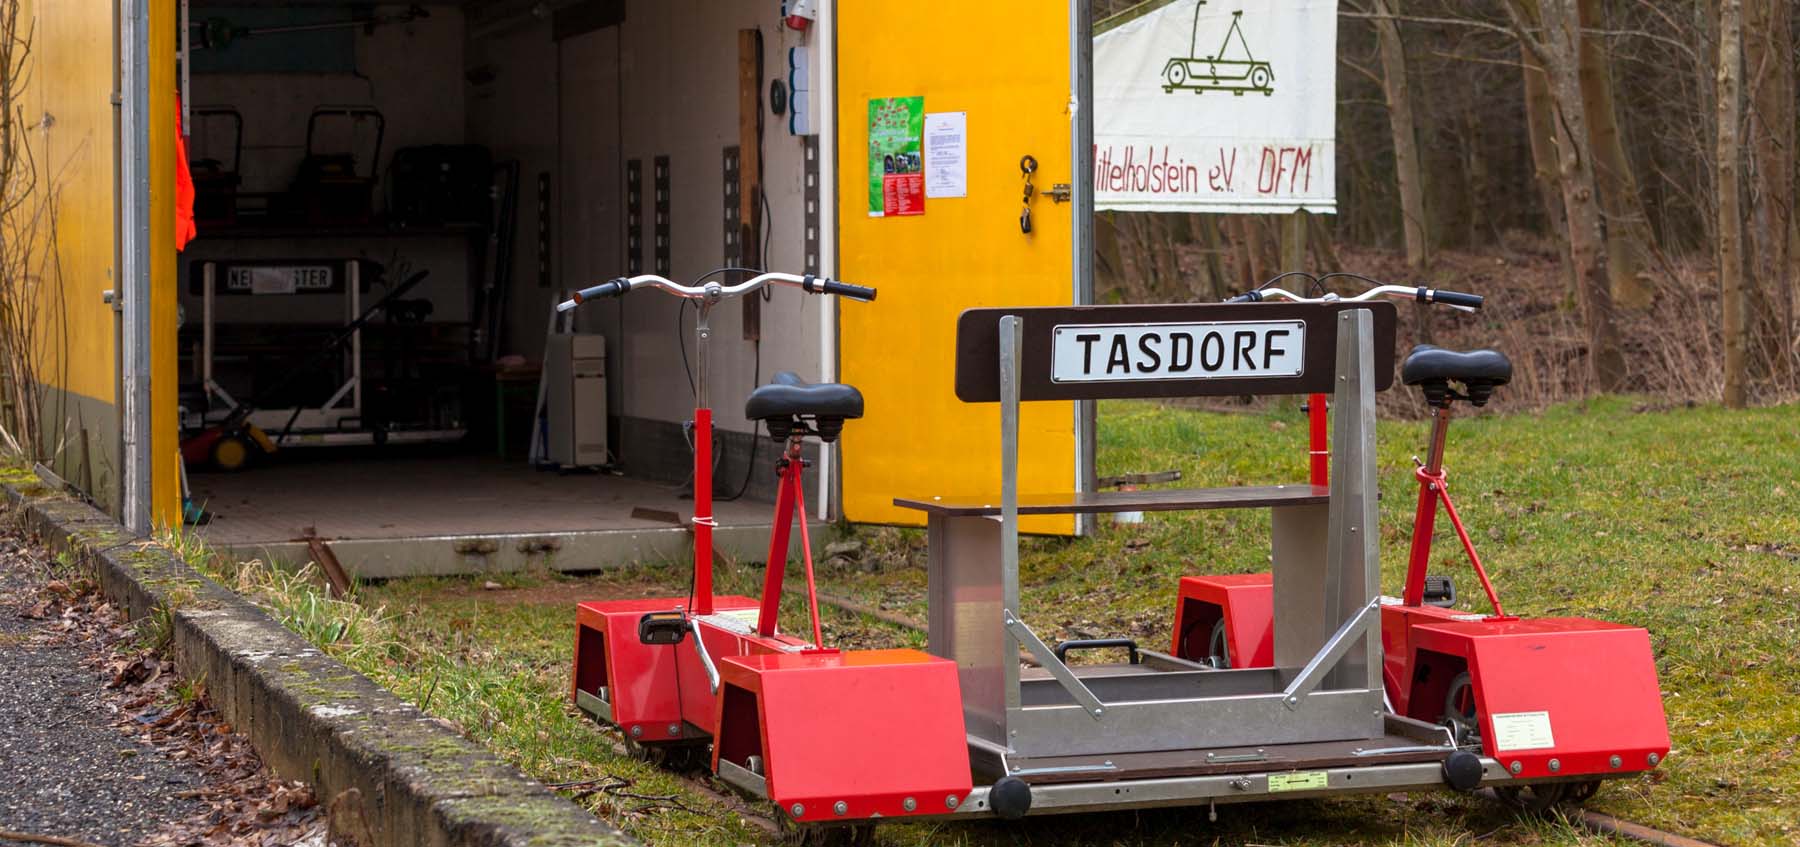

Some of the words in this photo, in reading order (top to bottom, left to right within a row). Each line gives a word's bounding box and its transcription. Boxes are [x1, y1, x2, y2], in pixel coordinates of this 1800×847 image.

[1092, 144, 1198, 194] ittelholstein
[1258, 146, 1312, 194] DFM
[1076, 330, 1290, 374] TASDORF
